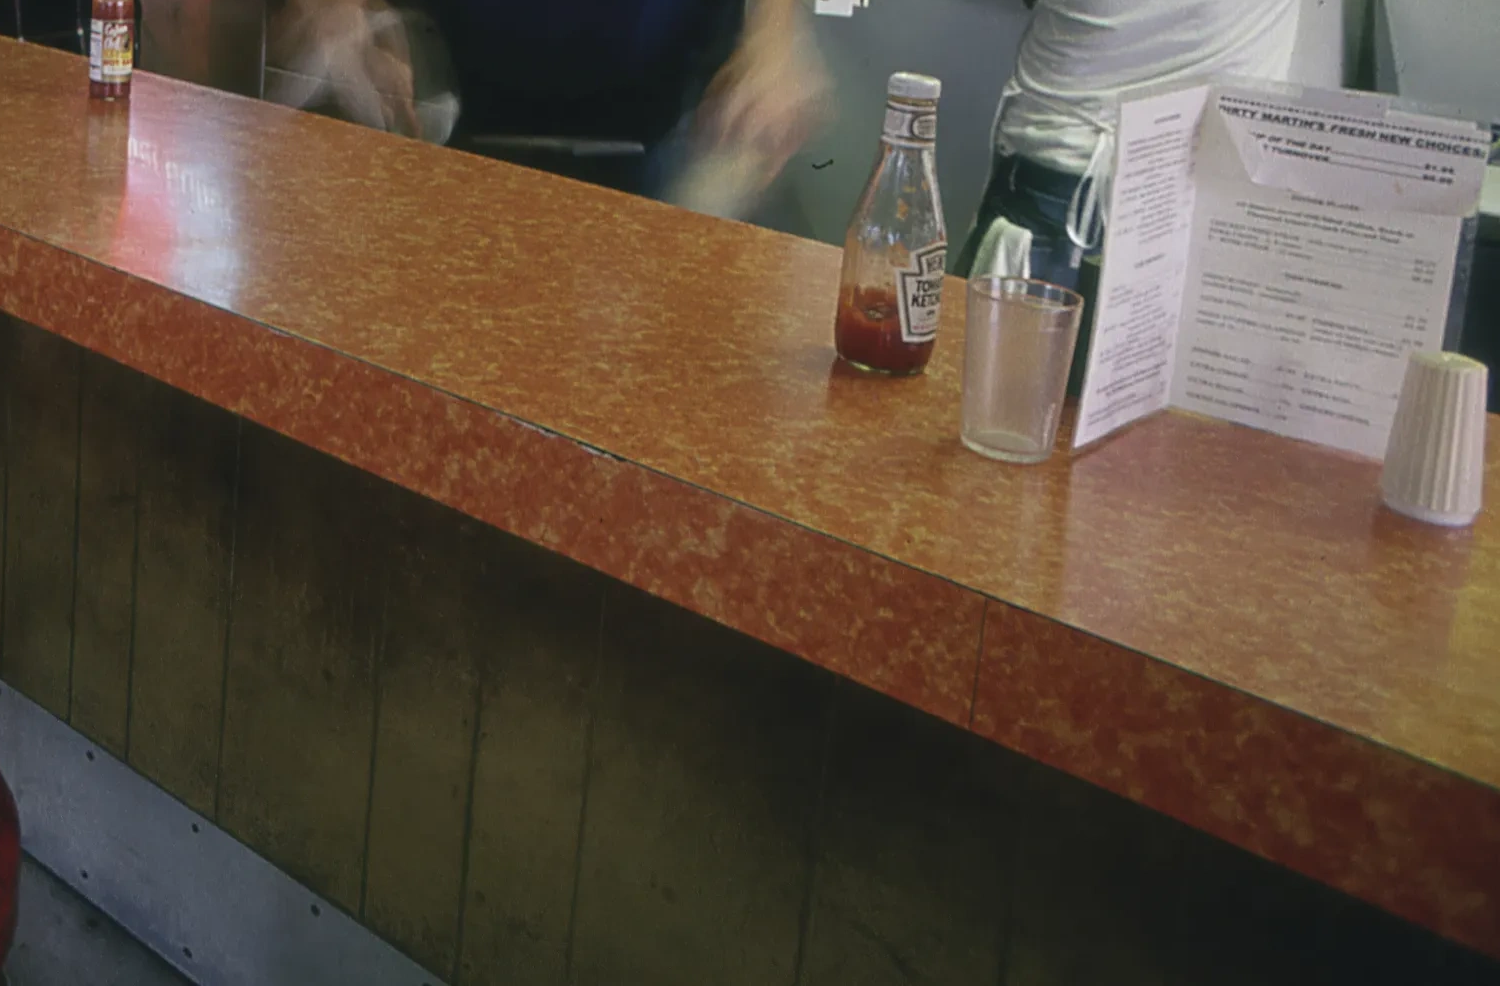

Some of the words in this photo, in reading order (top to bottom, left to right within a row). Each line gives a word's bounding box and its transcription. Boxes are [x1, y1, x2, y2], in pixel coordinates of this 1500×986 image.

[1260, 112, 1325, 132] MARTIN'S
[1329, 123, 1377, 140] FRESH
[1379, 132, 1412, 146] NEW
